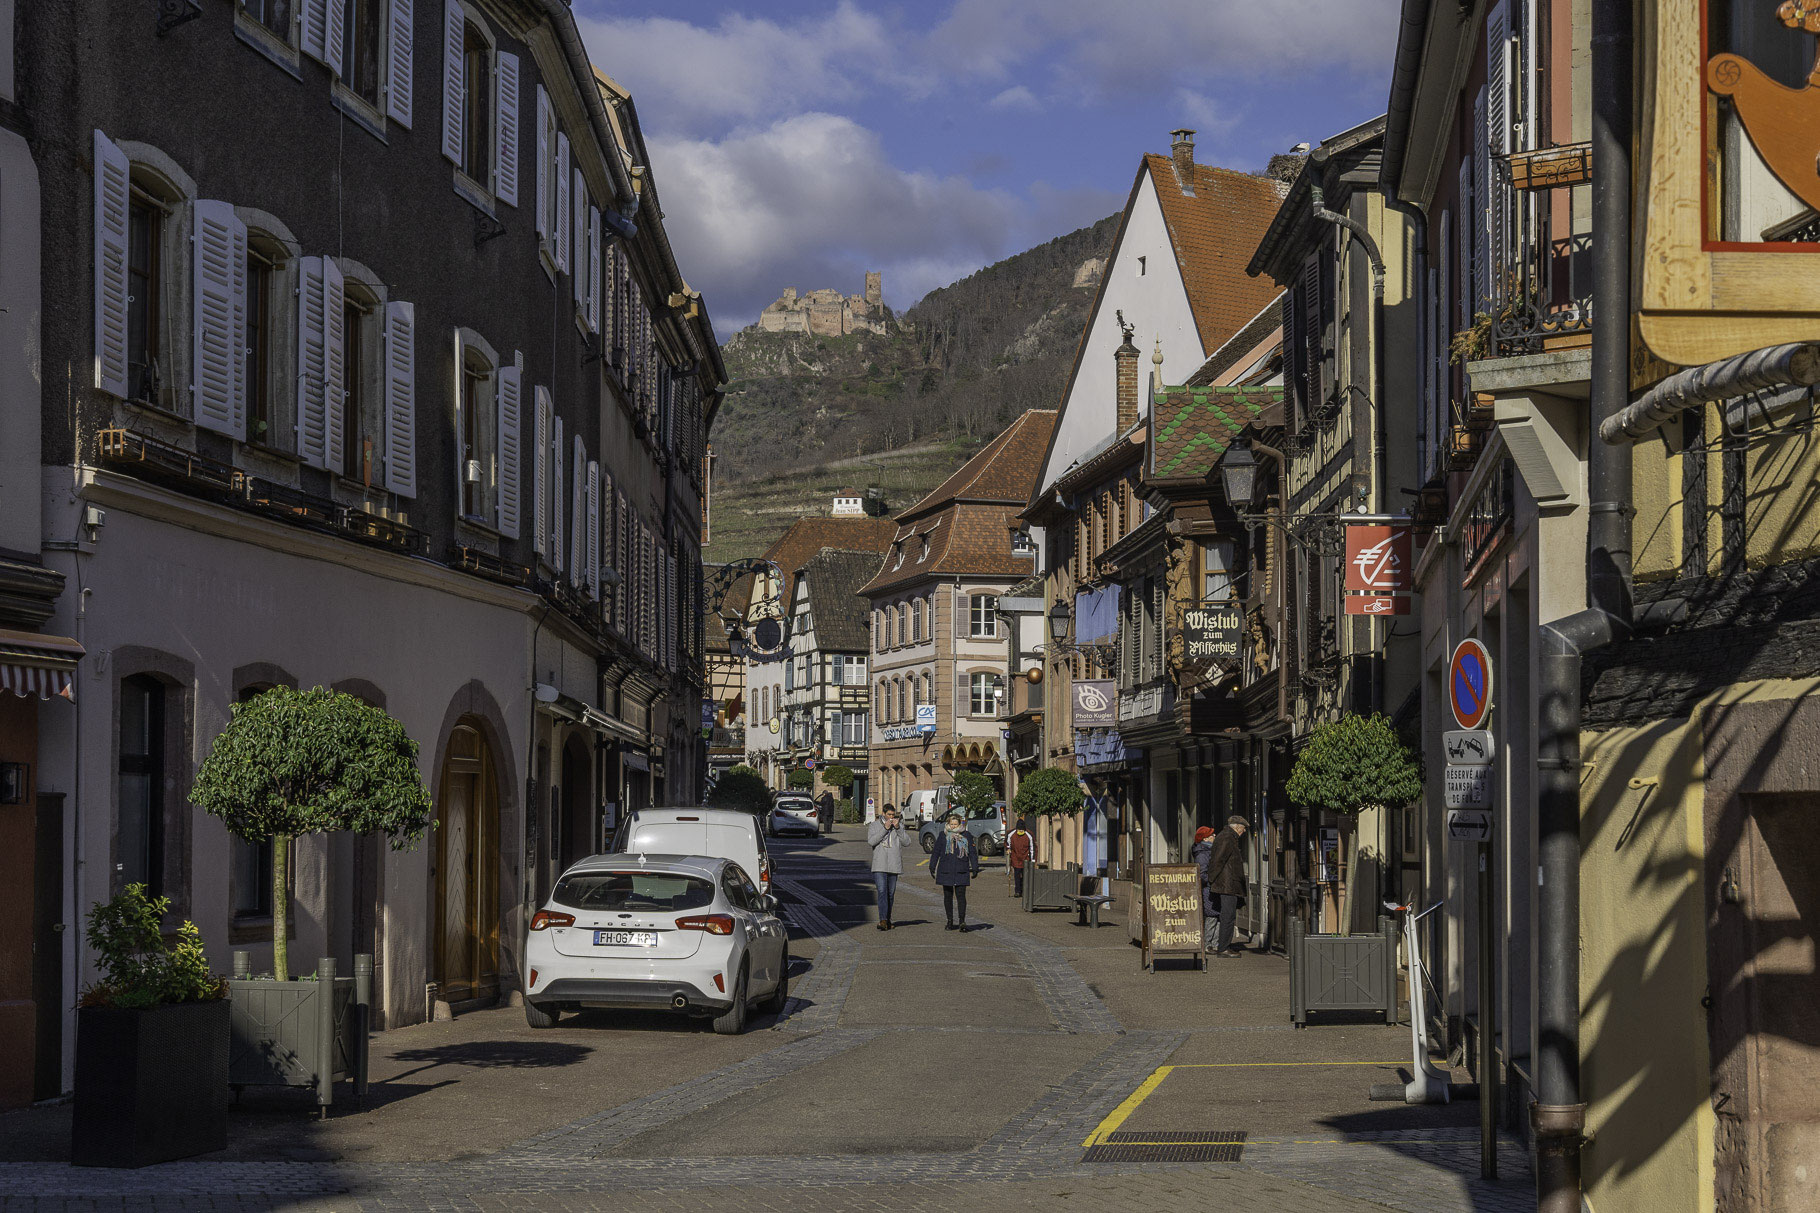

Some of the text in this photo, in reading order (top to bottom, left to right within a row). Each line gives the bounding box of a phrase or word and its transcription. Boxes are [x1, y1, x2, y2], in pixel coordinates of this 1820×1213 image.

[1185, 610, 1239, 631] Wistub
[1203, 631, 1223, 639] zum
[1188, 640, 1237, 656] Pfifferhüs
[1093, 712, 1113, 720] Kugler
[1446, 768, 1487, 780] RÉSERVÉ AUX
[1452, 794, 1460, 804] DE
[1149, 873, 1196, 884] RESTAURANT
[1150, 893, 1198, 913] Wistub
[1165, 918, 1186, 926] zum
[1151, 928, 1201, 945] Pfifferhüs
